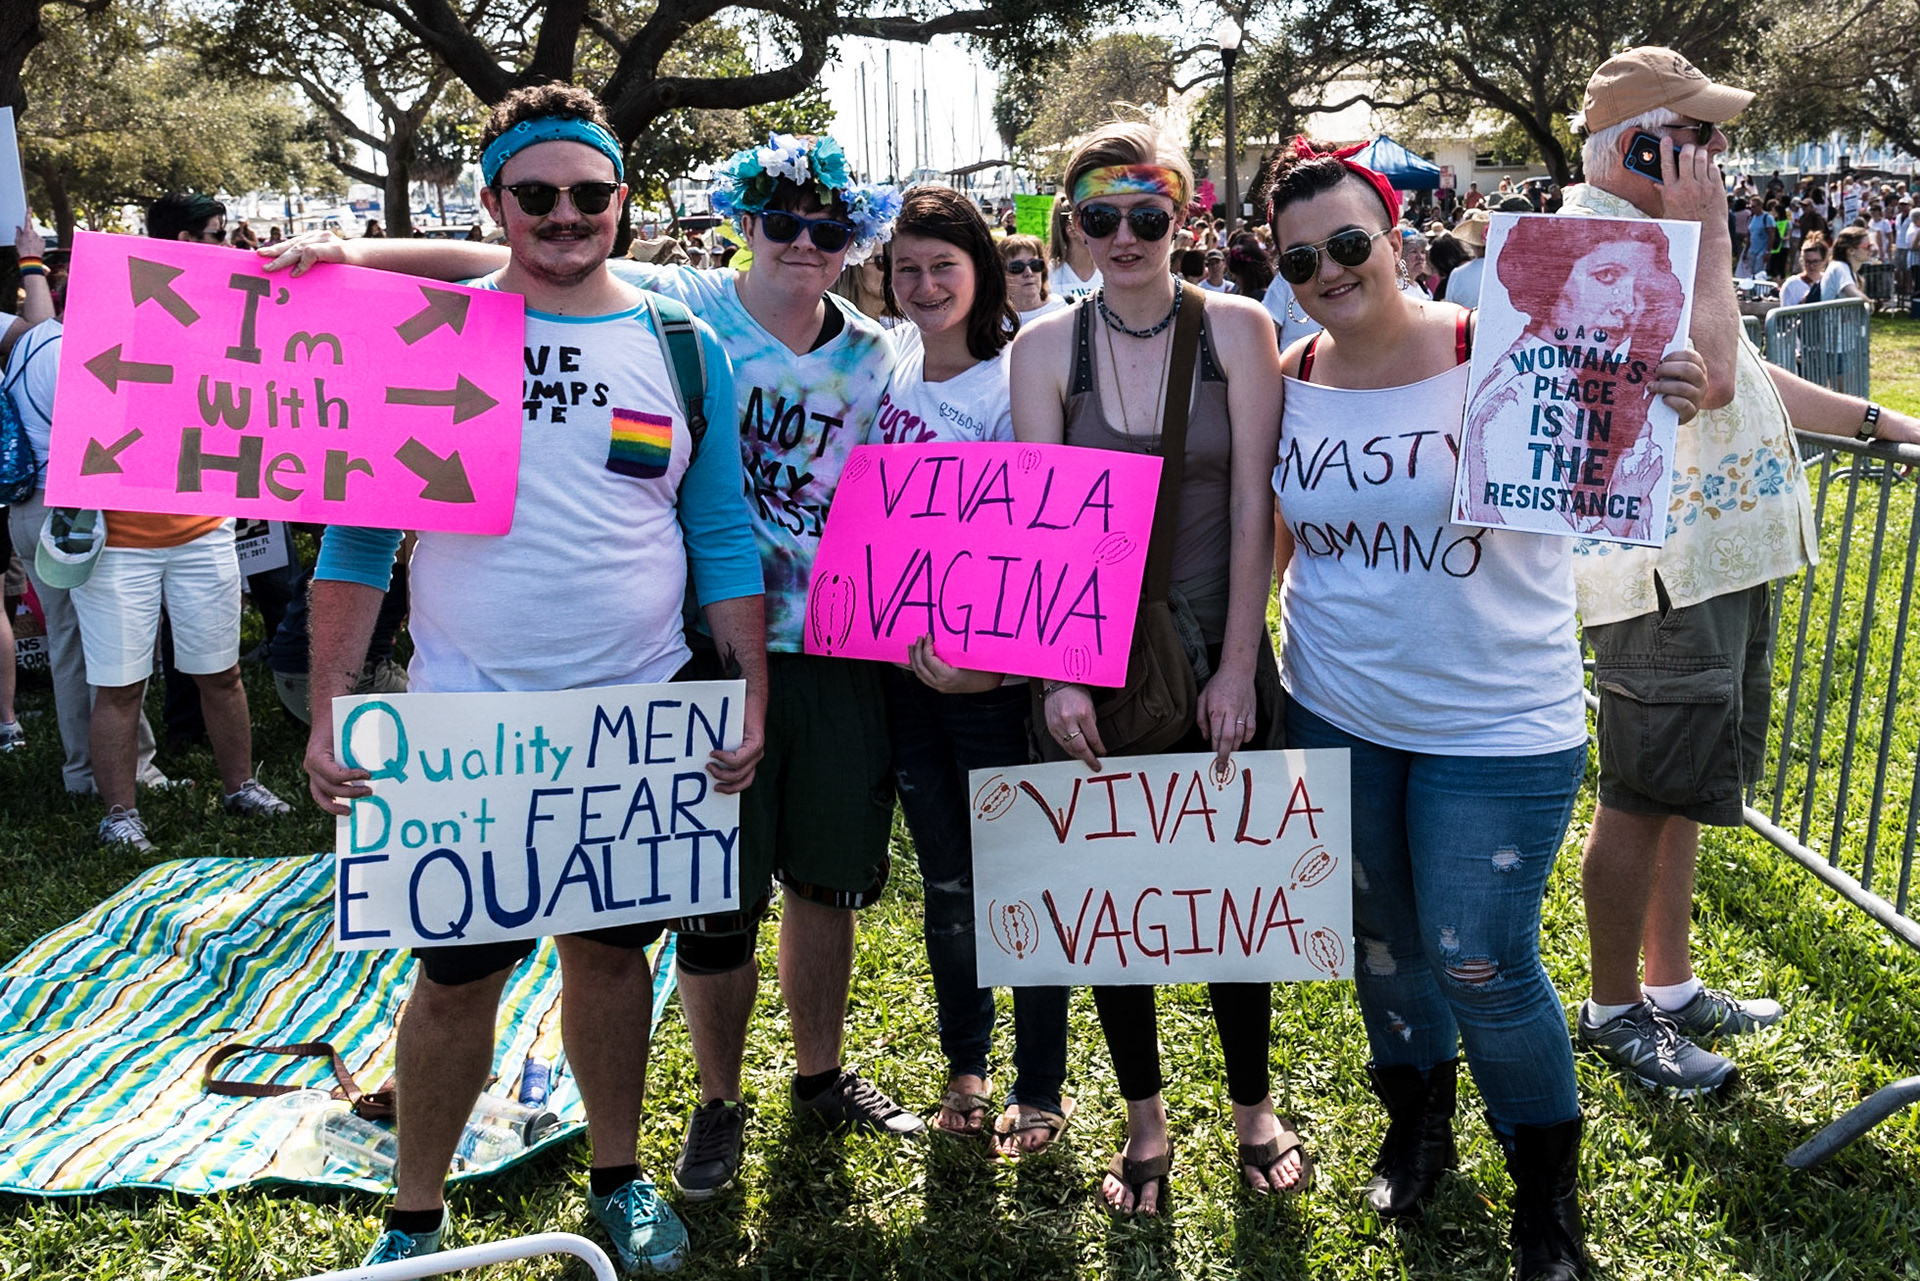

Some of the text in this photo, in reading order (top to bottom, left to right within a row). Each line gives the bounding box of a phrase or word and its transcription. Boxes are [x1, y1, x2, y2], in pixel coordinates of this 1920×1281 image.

[225, 273, 344, 365] I'm
[1575, 324, 1585, 340] A
[523, 380, 610, 407] MPS
[1510, 344, 1648, 385] WOMAN'S
[1533, 375, 1617, 406] PLACE
[197, 374, 349, 431] with
[740, 386, 844, 457] NOT
[1530, 404, 1612, 443] IS IN
[176, 427, 374, 502] Her
[747, 451, 816, 499] MY
[880, 456, 1114, 533] VIVA LA
[1528, 442, 1608, 487] THE
[1483, 482, 1643, 520] RESISTANCE
[865, 543, 1107, 656] VAGINA
[341, 696, 729, 784] Quality MEN
[350, 771, 708, 855] Don't FEAR
[1018, 768, 1324, 845] VIVA LA
[340, 827, 740, 941] EQUALITY
[1042, 886, 1304, 967] VAGINA
